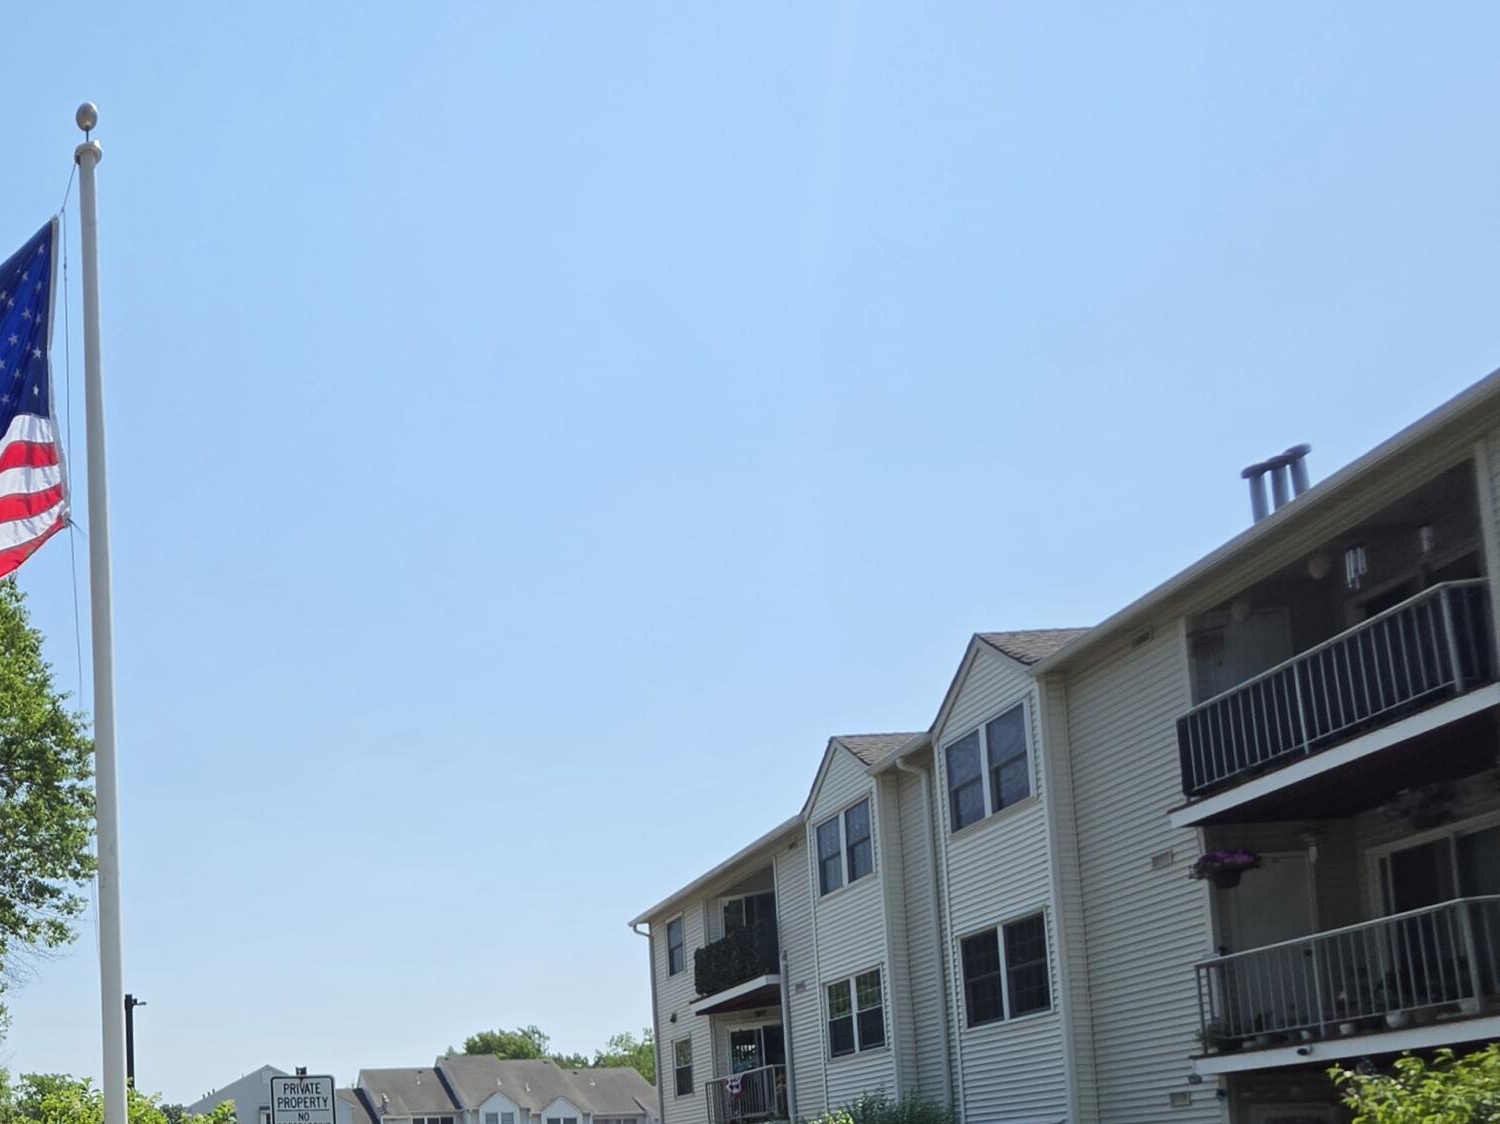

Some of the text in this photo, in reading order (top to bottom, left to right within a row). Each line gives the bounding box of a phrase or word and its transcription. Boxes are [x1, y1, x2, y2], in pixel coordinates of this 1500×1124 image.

[283, 1083, 321, 1094] PRIVATE
[277, 1096, 328, 1109] PROPERTY
[298, 1112, 310, 1121] NO
